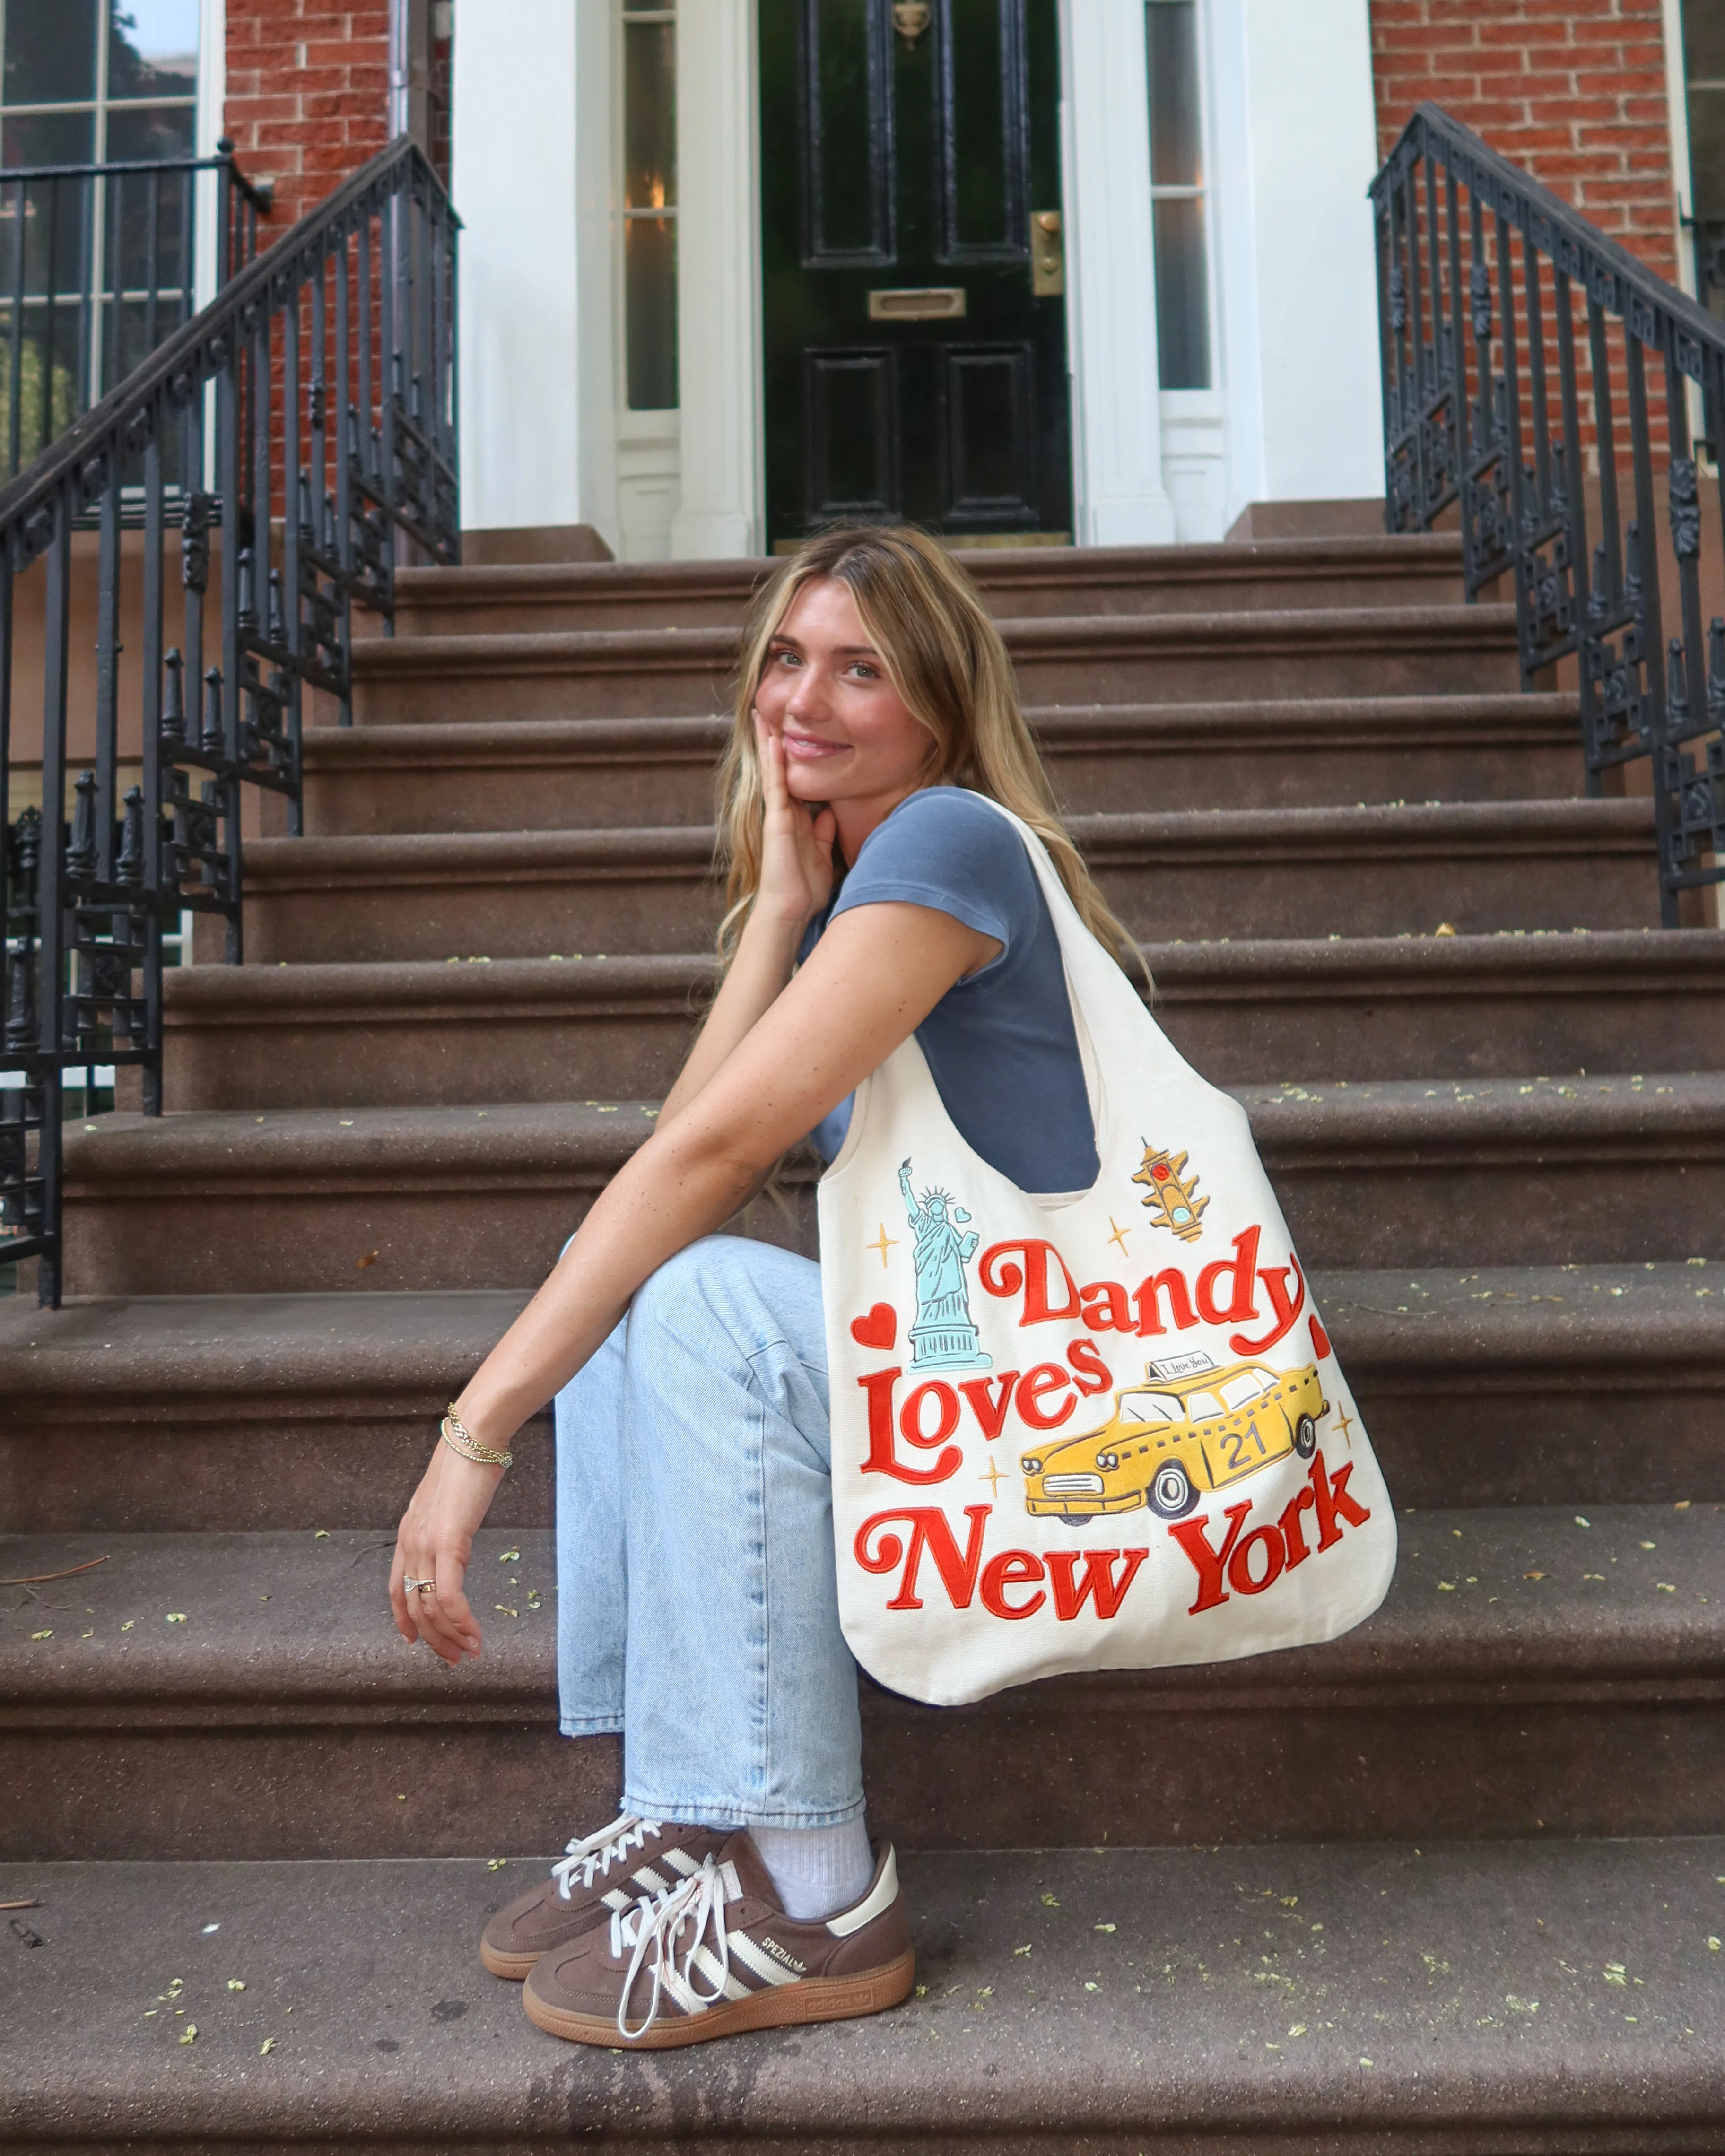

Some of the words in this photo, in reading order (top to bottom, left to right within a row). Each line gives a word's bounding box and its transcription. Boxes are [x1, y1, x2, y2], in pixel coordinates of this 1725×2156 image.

[978, 1225, 1305, 1356] Dandy
[1160, 1364, 1172, 1374] I
[857, 1339, 1113, 1486] Loves
[1220, 1421, 1266, 1469] 21
[854, 1504, 1150, 1621] New
[1167, 1449, 1371, 1616] York
[762, 1937, 795, 1968] SPEZIAL
[808, 1998, 851, 2010] adidas
